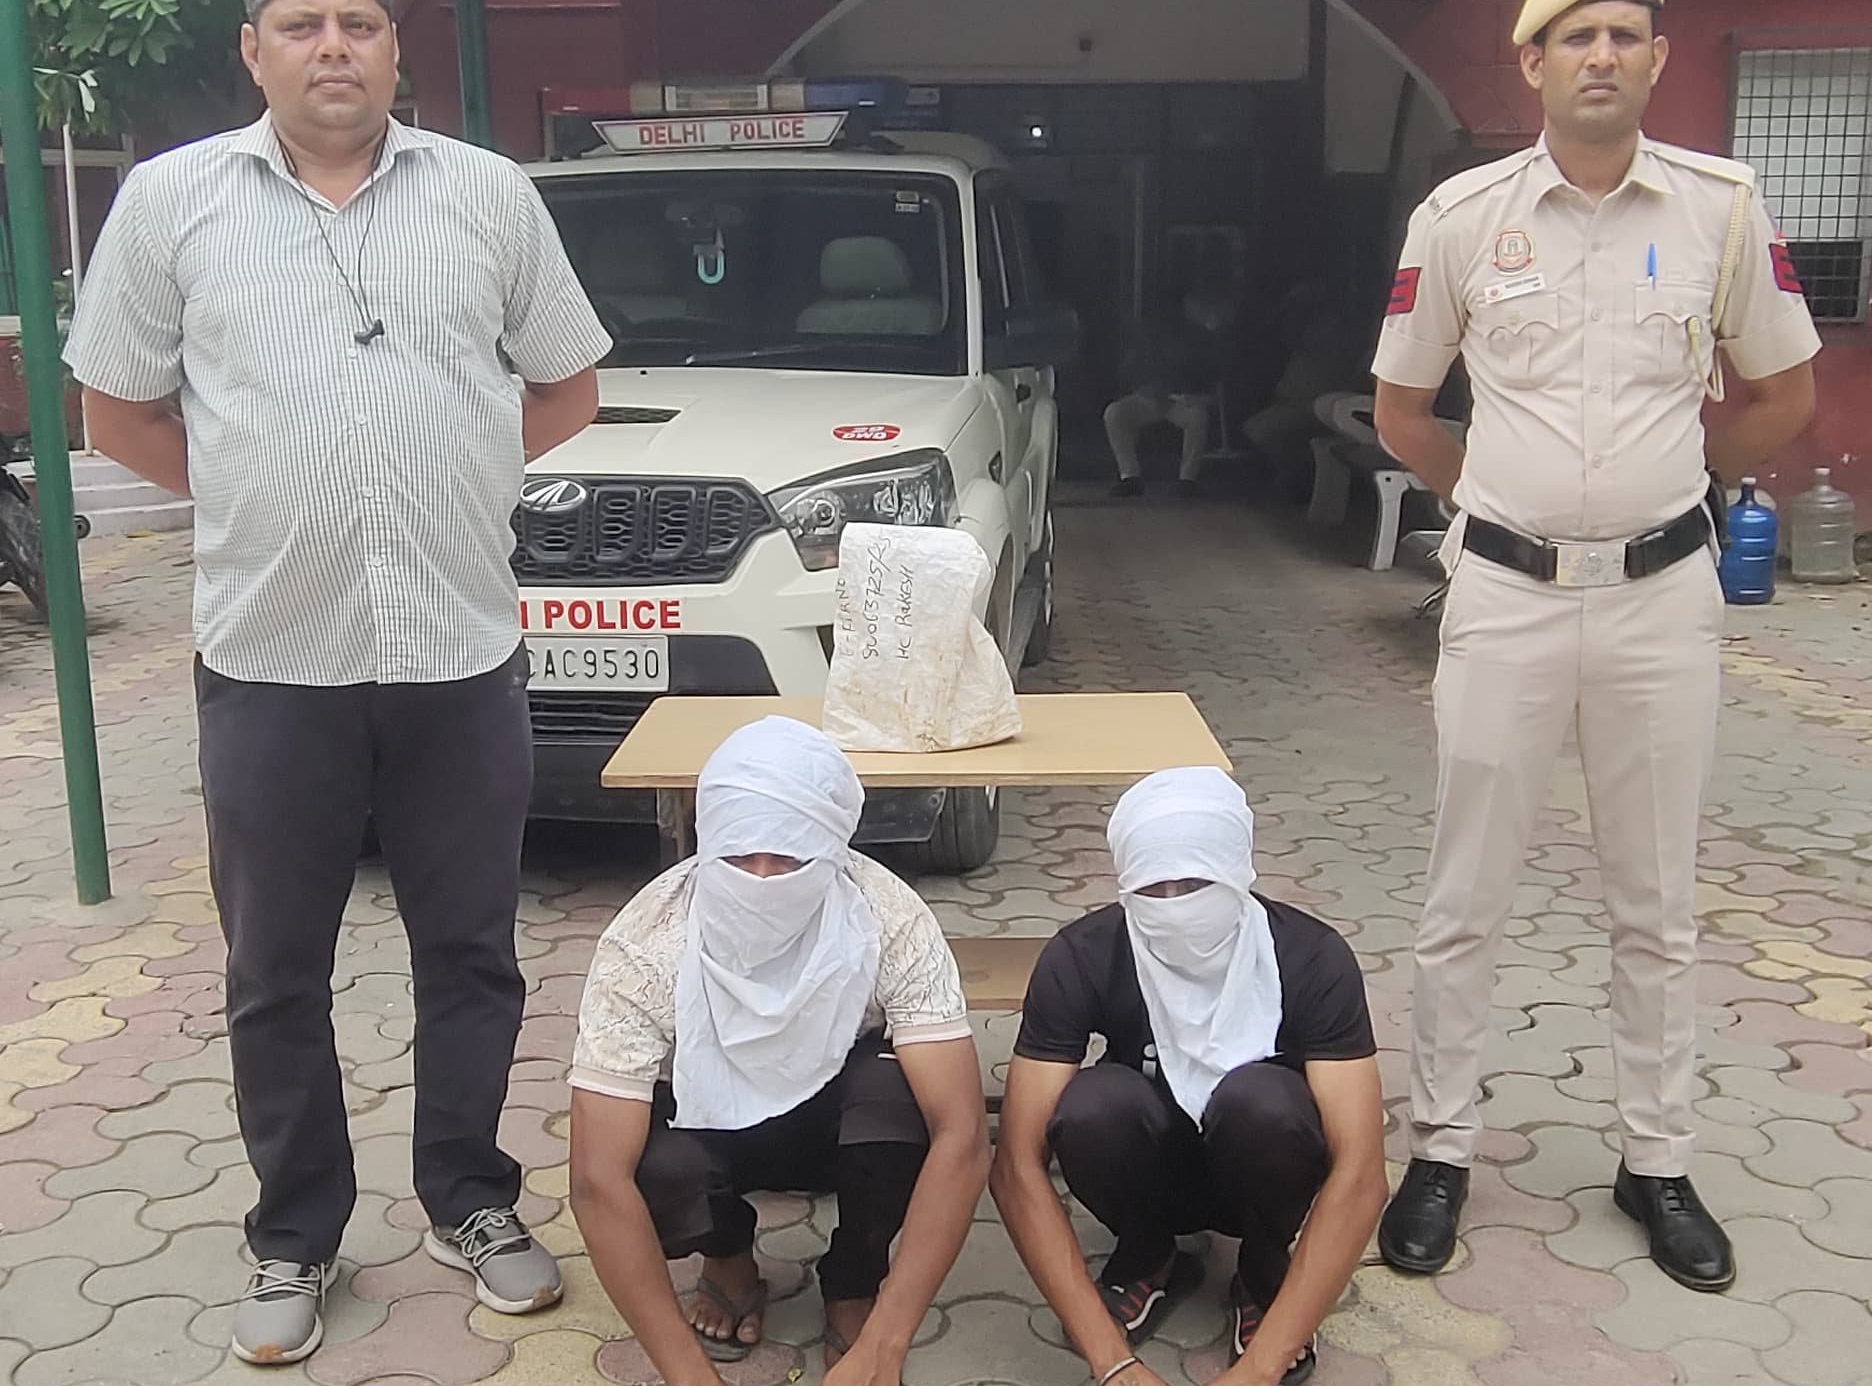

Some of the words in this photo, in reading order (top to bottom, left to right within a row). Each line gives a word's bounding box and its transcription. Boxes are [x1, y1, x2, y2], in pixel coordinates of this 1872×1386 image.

[639, 124, 705, 145] DELHI
[730, 120, 805, 142] POLICE
[543, 600, 681, 629] POLICE
